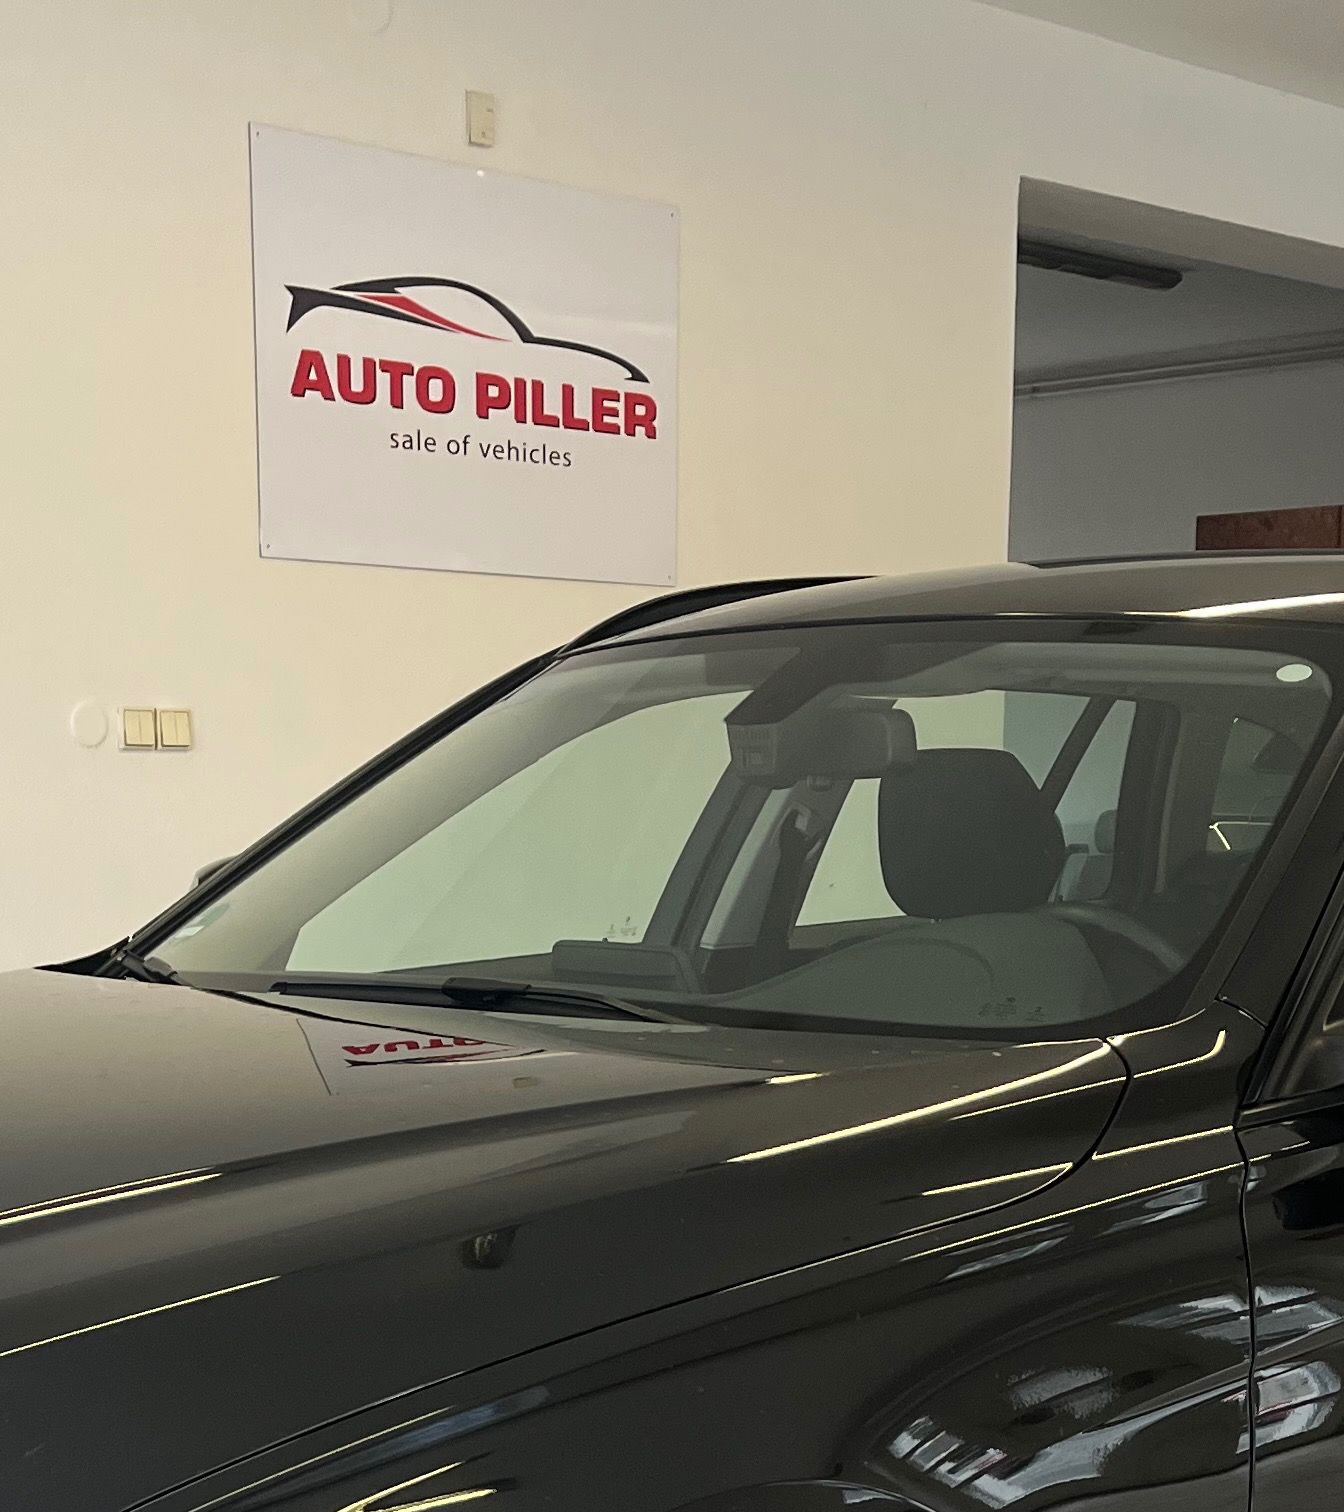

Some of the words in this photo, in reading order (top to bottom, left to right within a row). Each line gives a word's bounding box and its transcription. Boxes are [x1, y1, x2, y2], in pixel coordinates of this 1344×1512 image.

[290, 349, 456, 415] AUTO
[475, 371, 658, 440] PILLER
[389, 429, 438, 455] sale
[447, 434, 471, 456] of
[479, 440, 573, 468] vehicles
